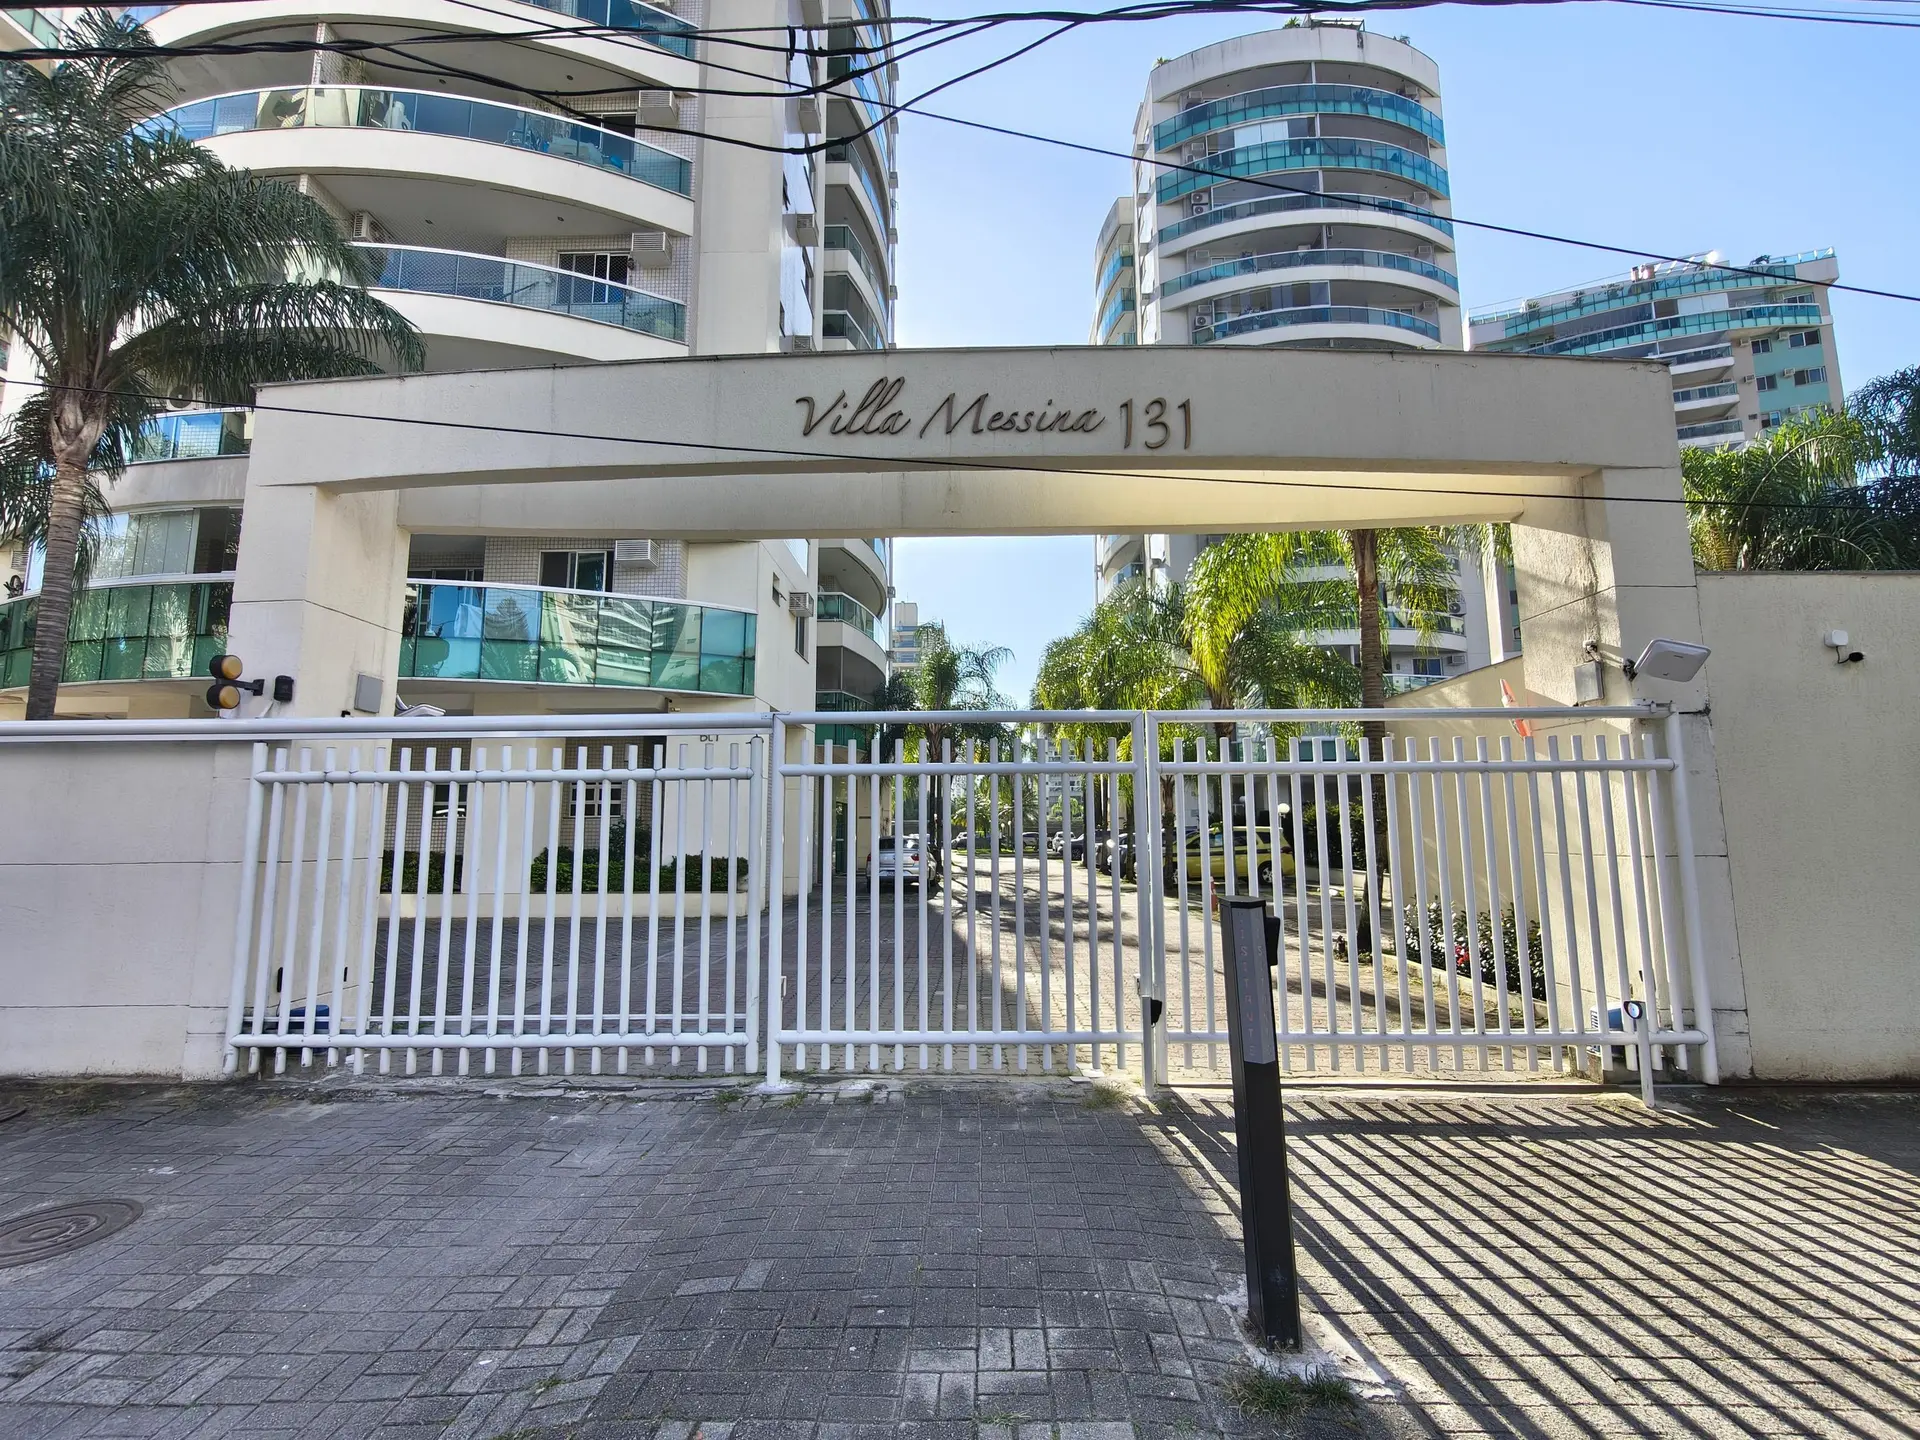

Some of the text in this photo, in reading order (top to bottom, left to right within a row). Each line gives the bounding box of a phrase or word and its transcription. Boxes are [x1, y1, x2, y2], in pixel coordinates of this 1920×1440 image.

[797, 376, 1191, 449] Villa Messina 131
